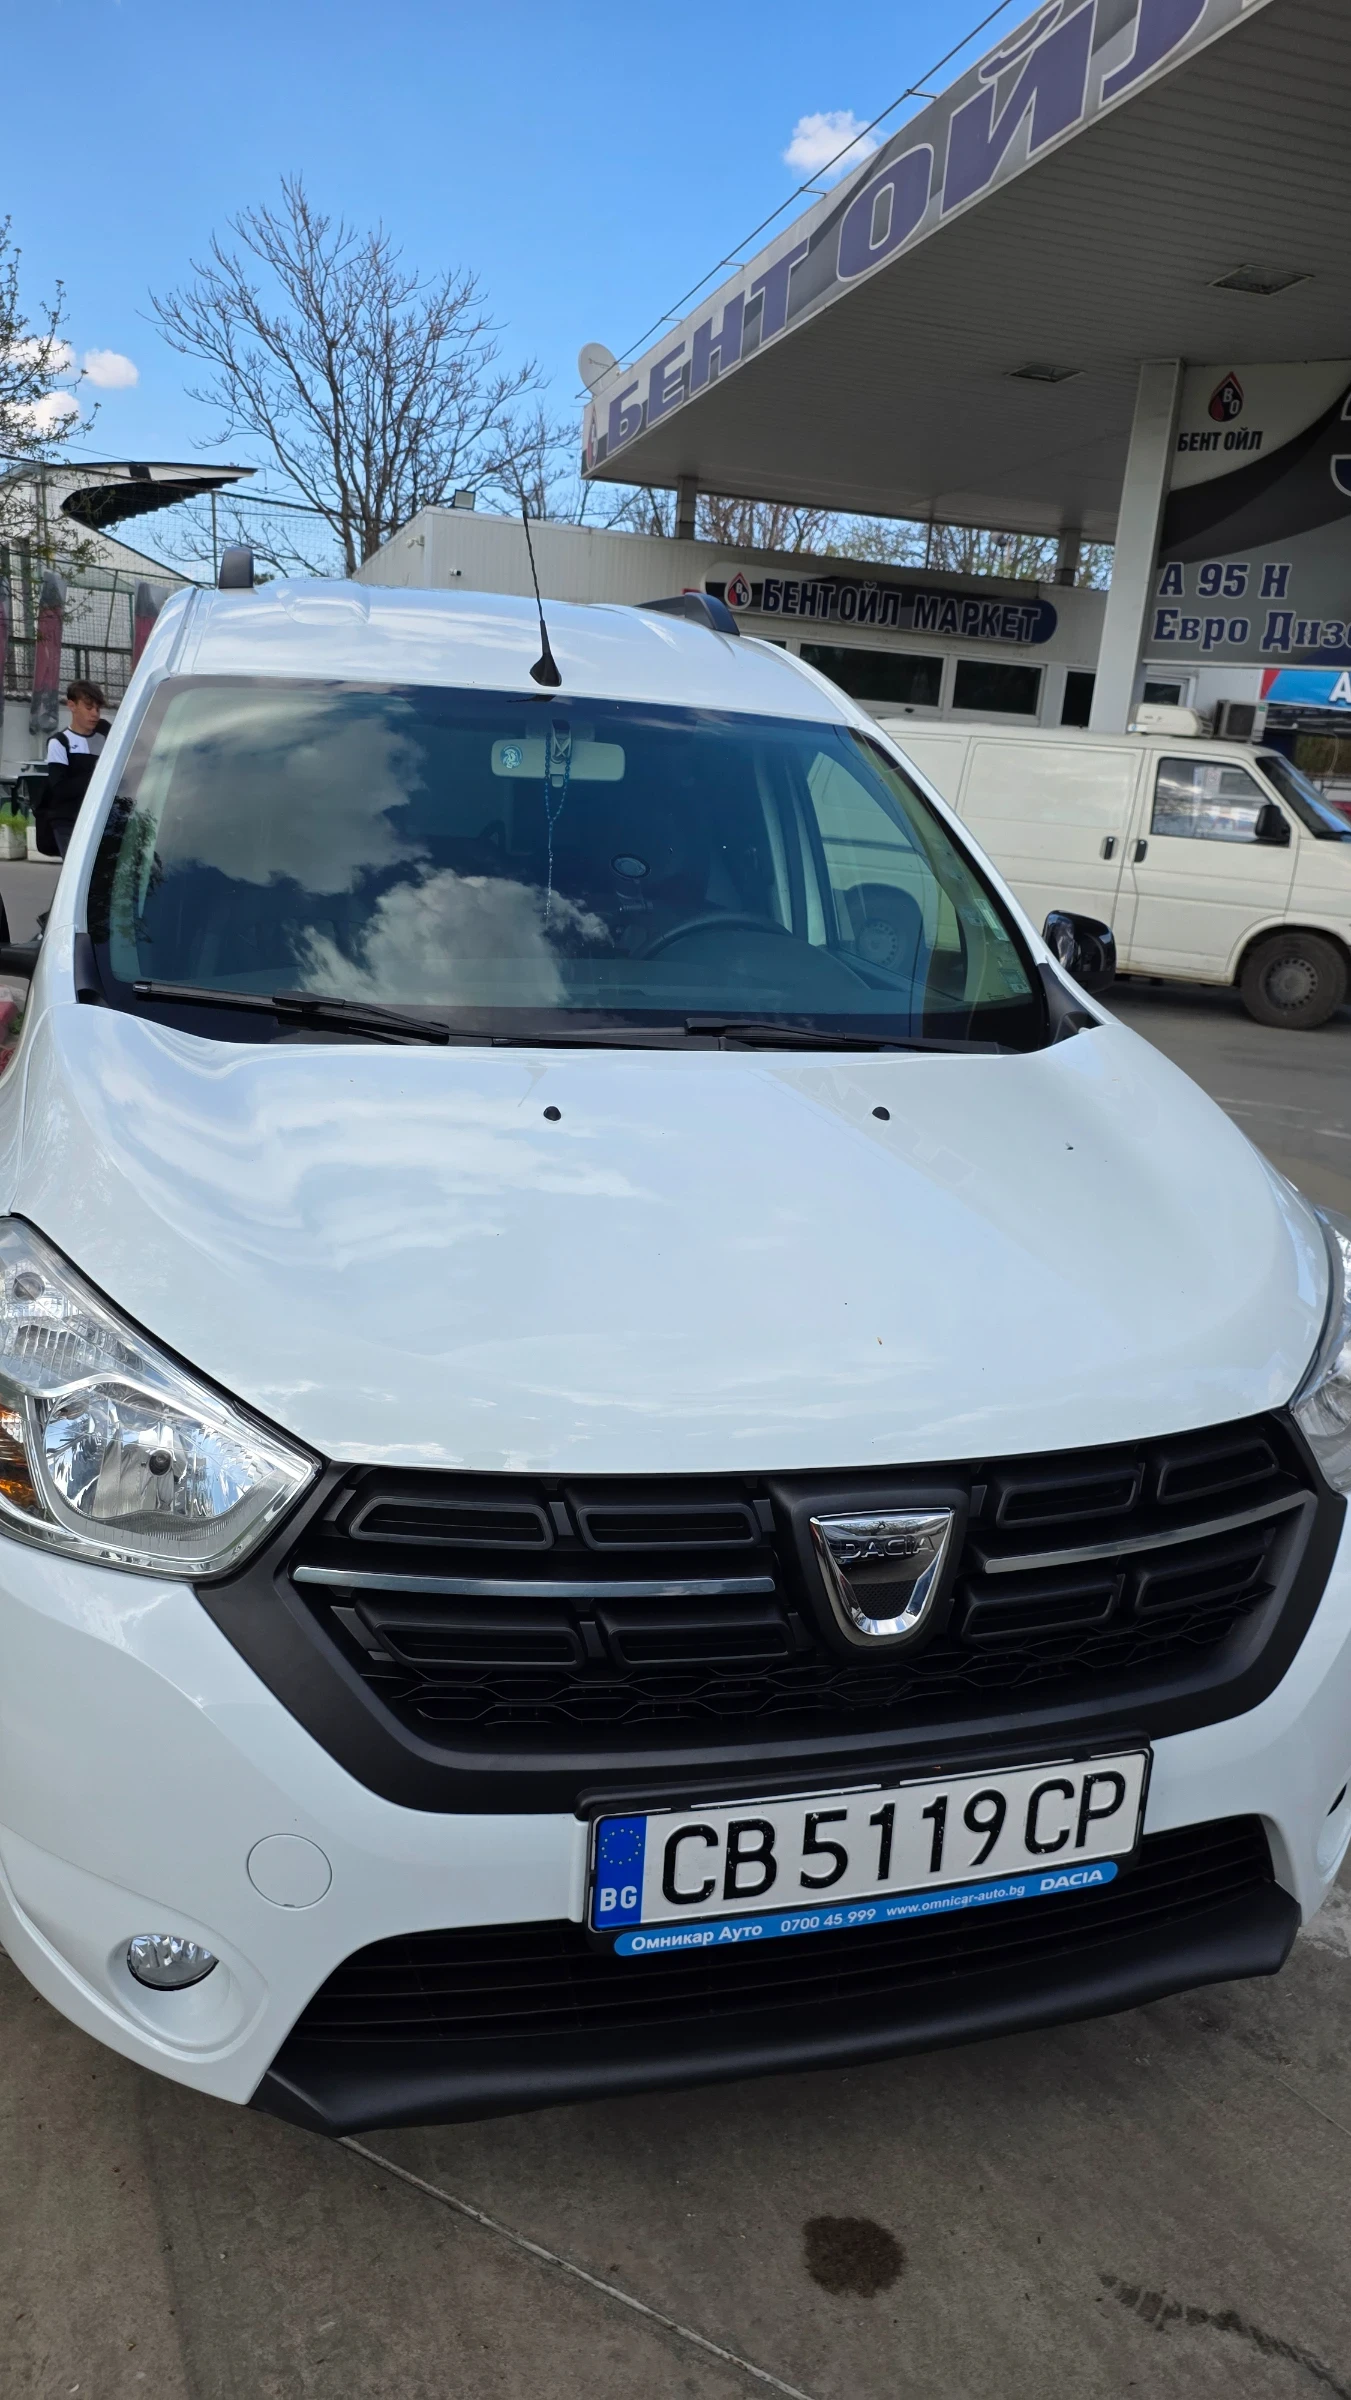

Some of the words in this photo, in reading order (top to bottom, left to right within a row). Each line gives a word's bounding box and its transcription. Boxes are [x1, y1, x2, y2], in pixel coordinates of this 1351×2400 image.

[606, 236, 809, 456] БЕНТ
[1177, 431, 1222, 452] БЕНТ
[1223, 427, 1263, 451] ОЙЛ
[1196, 562, 1249, 599] 95
[760, 577, 837, 620] БЕНТ
[837, 580, 902, 627] ОЙЛ
[911, 593, 1041, 643] МАРКЕТ
[1151, 606, 1250, 653] Евро
[1258, 610, 1351, 654] Диз
[840, 1535, 936, 1559] DACIA
[599, 1884, 638, 1913] BG
[631, 1928, 715, 1953] Омникар
[717, 1921, 764, 1944] Ауто
[780, 1916, 821, 1934] 0700
[822, 1913, 845, 1929] 45
[846, 1907, 877, 1925] 999
[886, 1884, 1026, 1918] www.omnicar-auto.bg
[1039, 1869, 1104, 1893] DACIA
